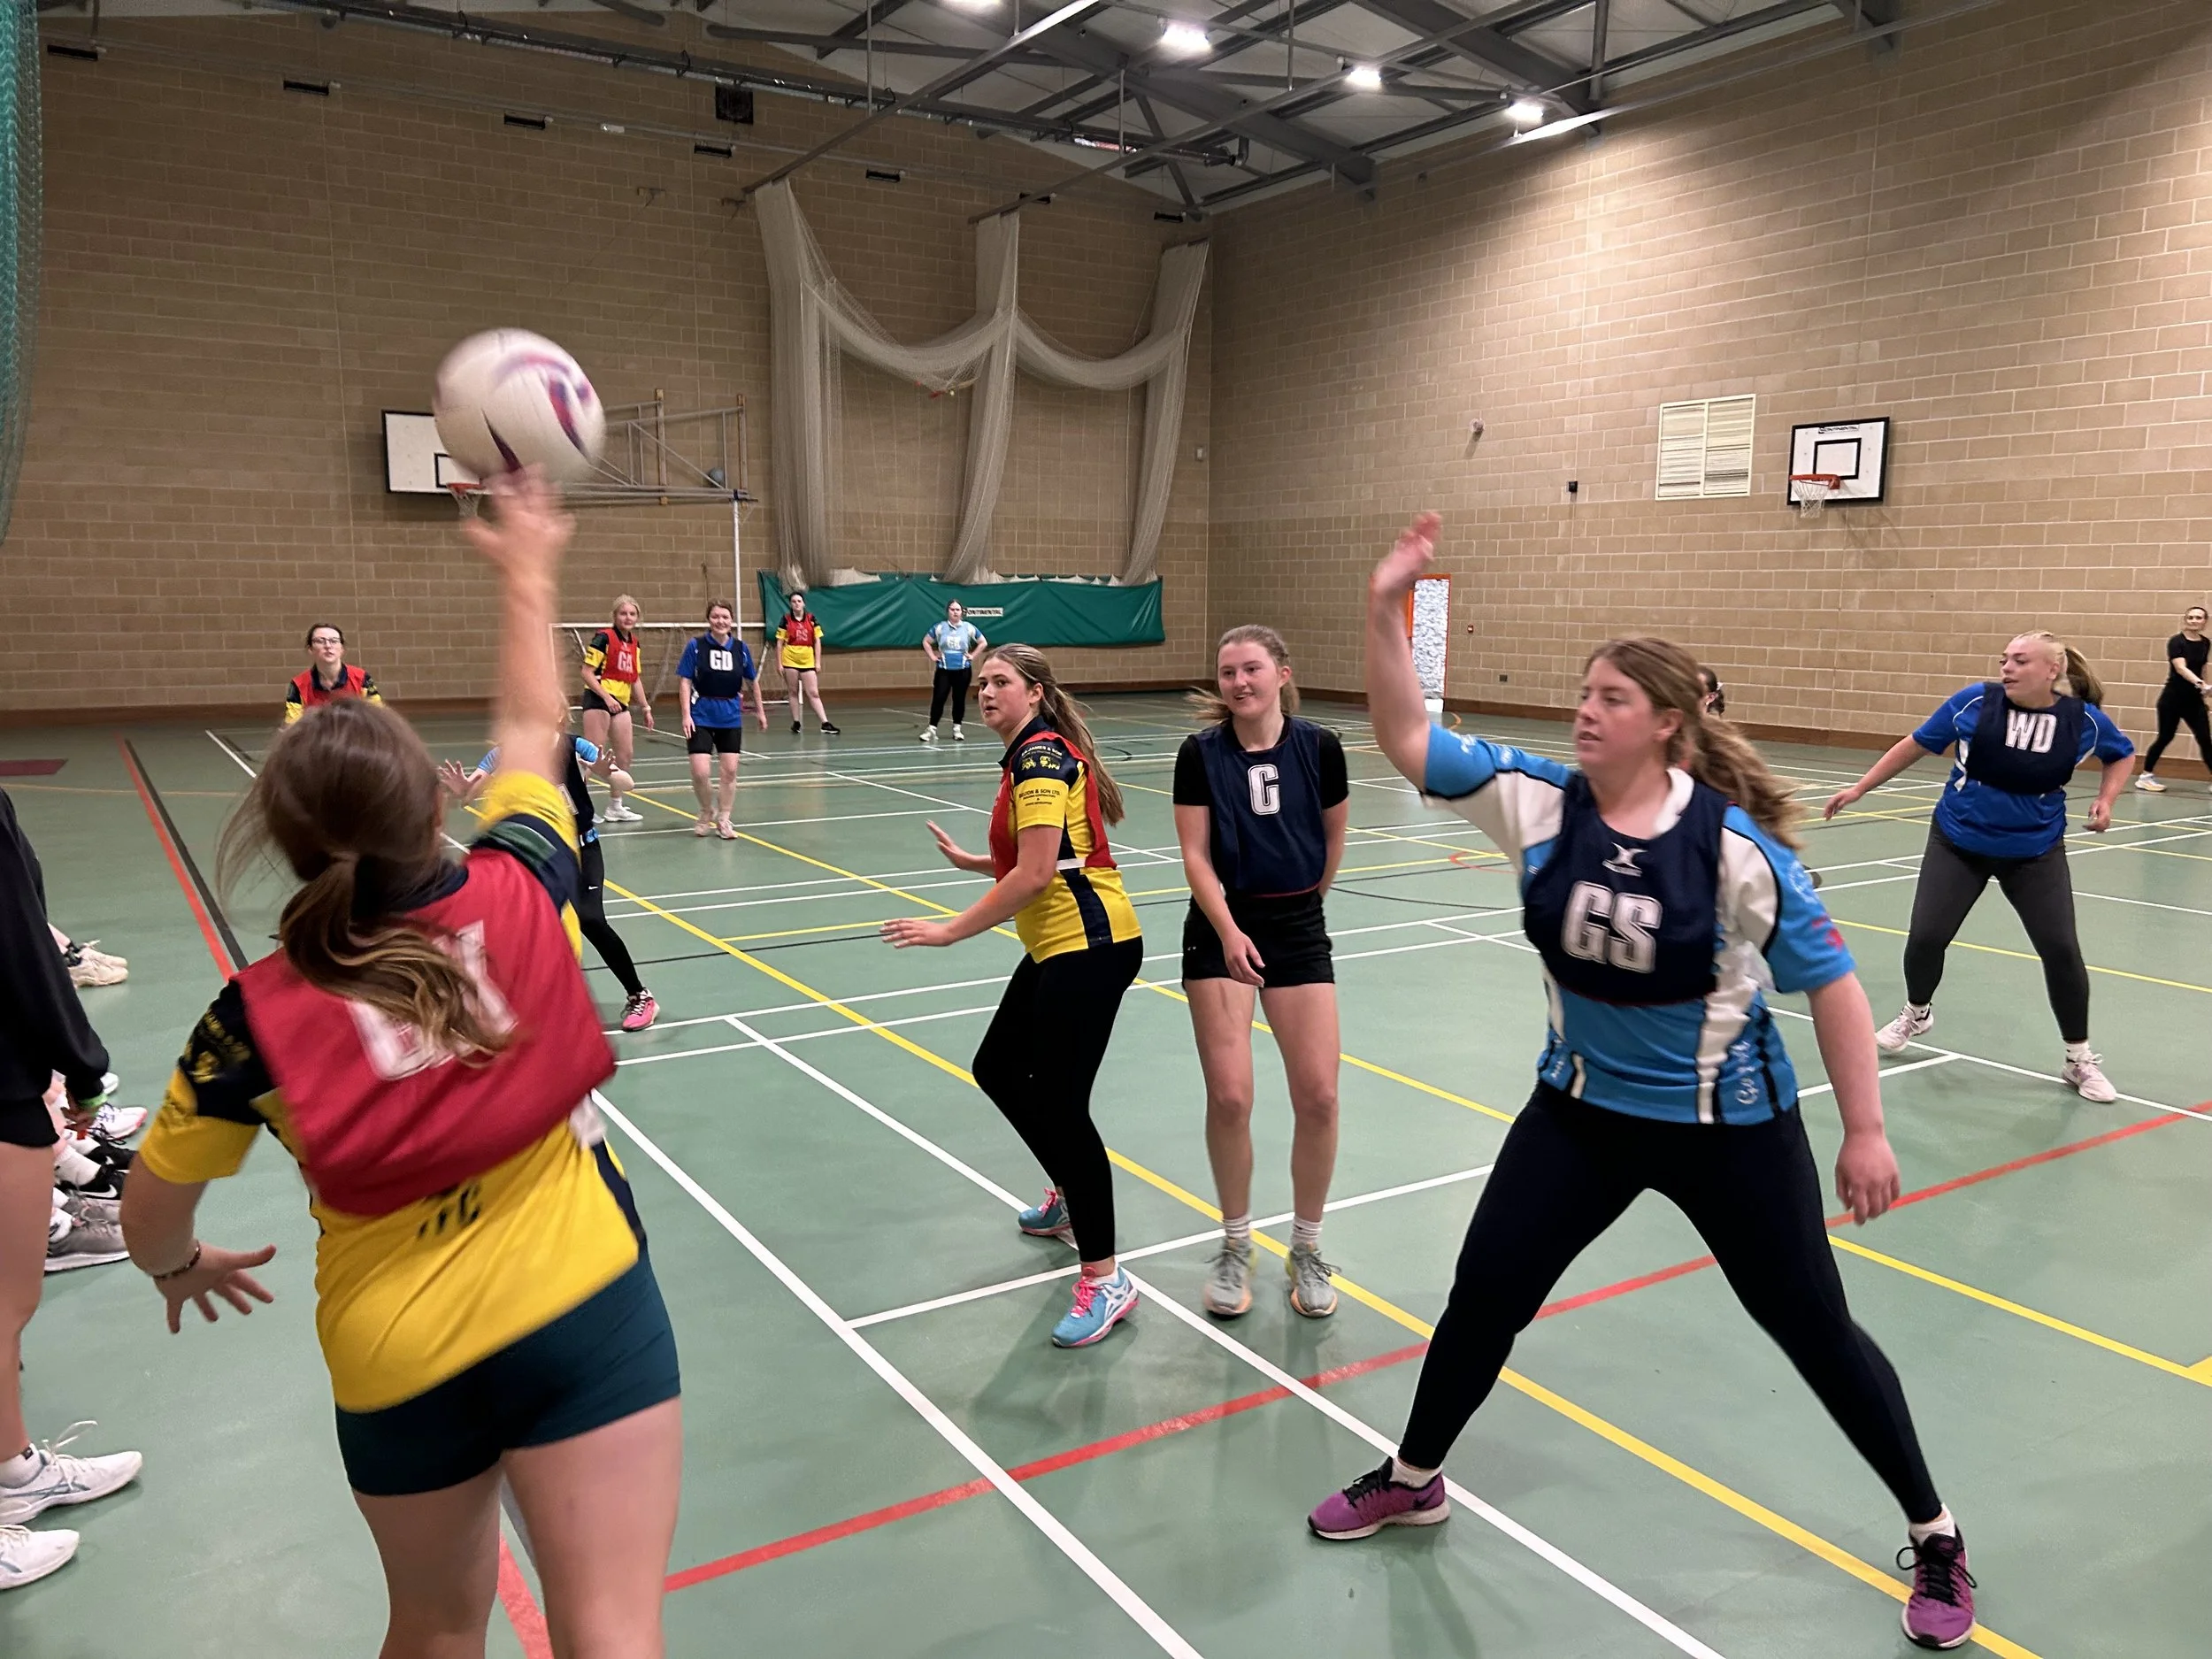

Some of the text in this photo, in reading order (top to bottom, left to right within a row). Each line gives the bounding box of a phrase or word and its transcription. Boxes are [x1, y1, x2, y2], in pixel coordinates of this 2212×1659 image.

[618, 651, 633, 672] GA
[710, 649, 733, 671] GD
[2005, 709, 2057, 754] WD
[1248, 764, 1280, 815] C
[1561, 880, 1663, 974] GS
